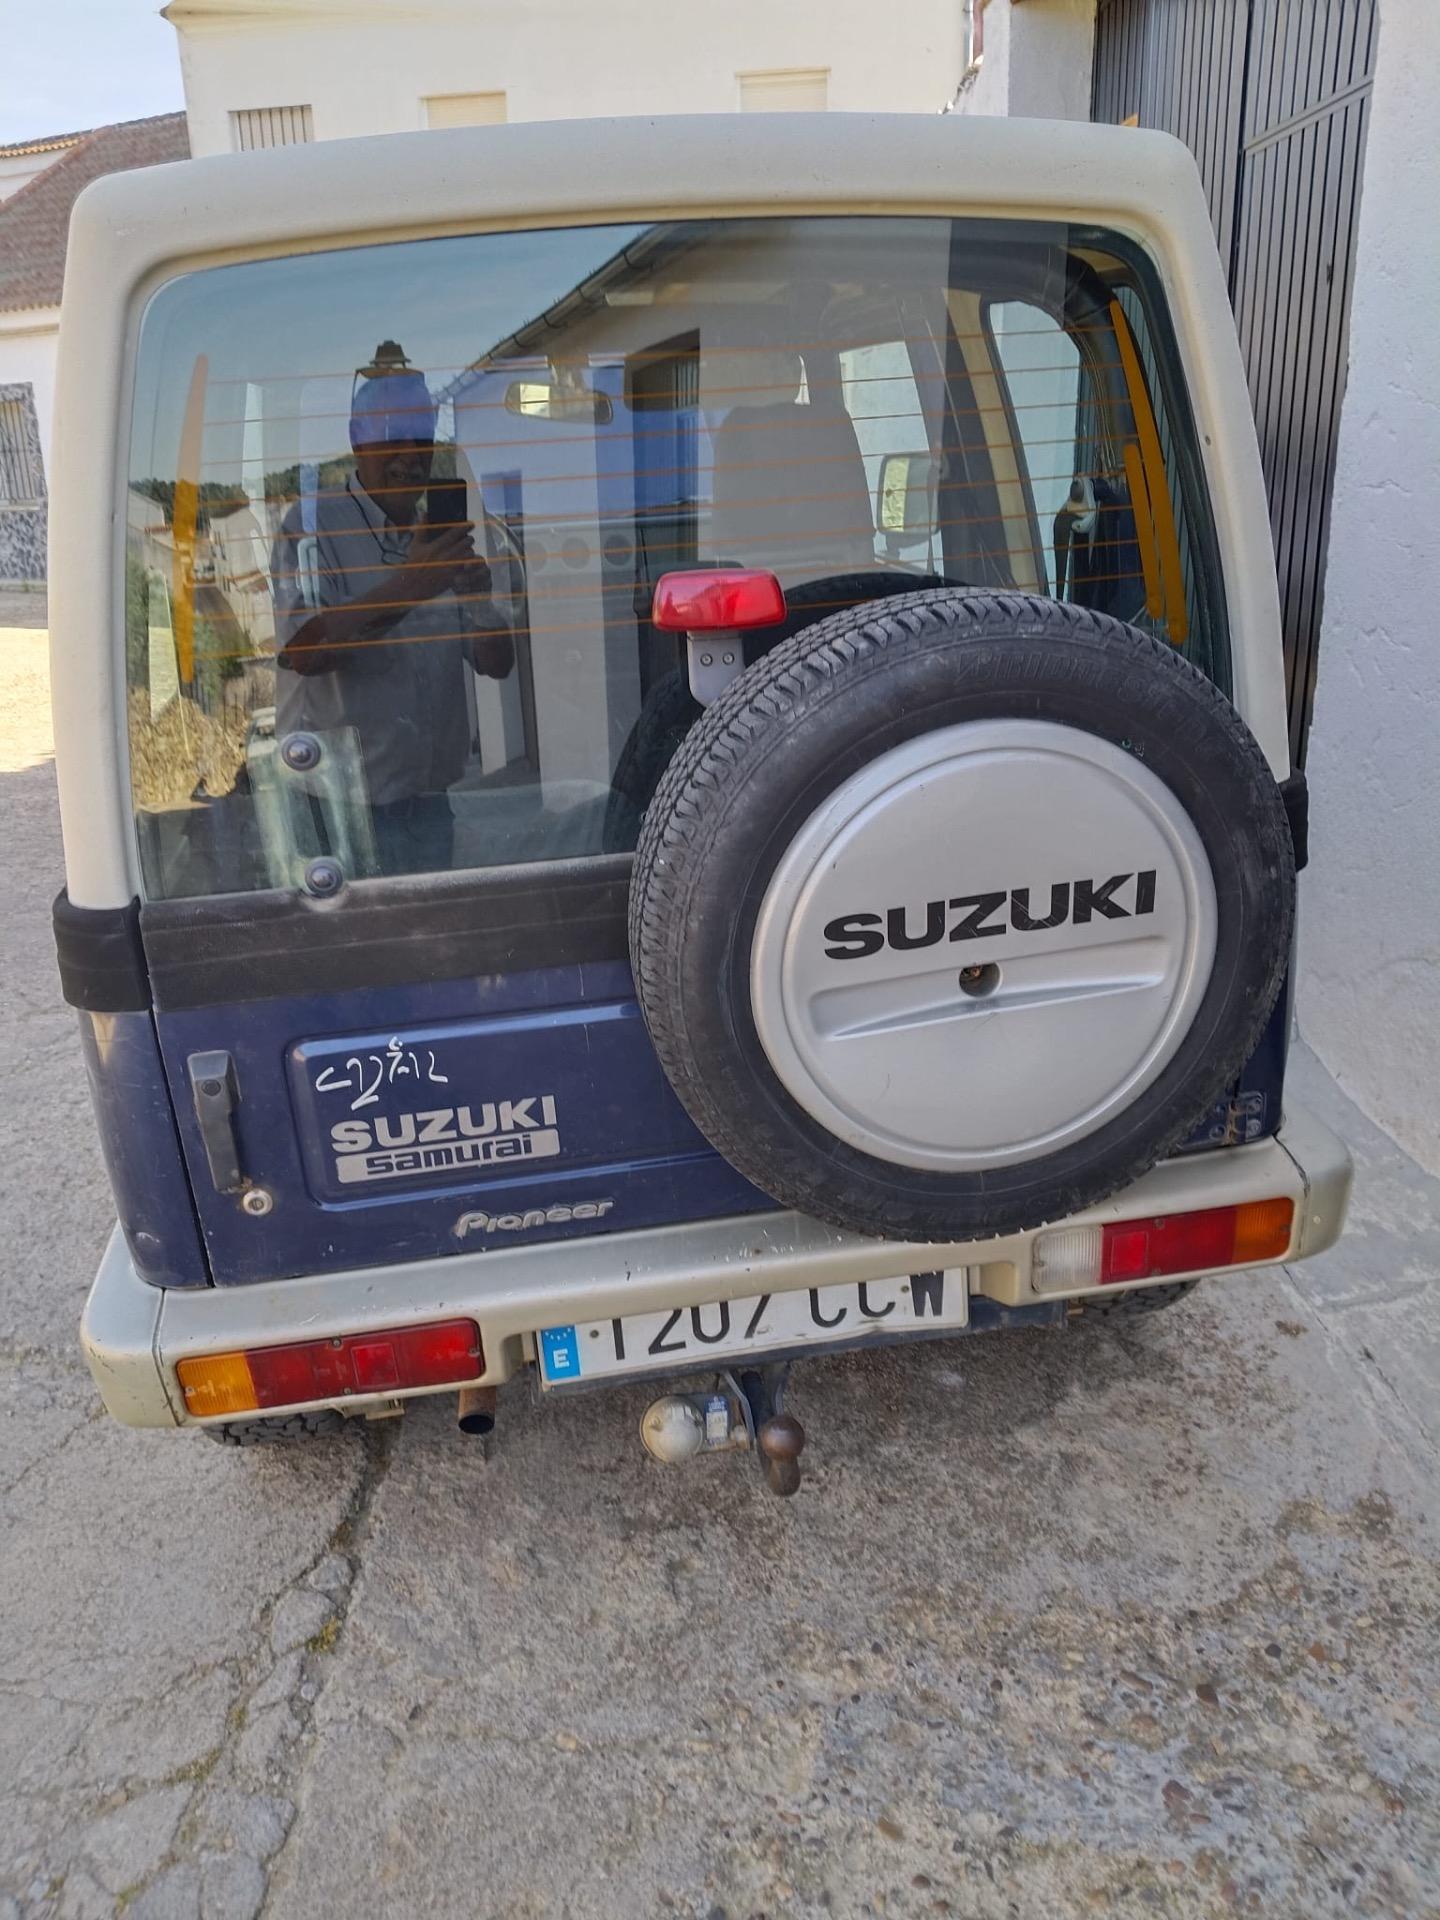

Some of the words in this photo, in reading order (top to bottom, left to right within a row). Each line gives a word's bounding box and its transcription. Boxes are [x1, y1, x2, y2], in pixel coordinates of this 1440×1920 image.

[823, 870, 1156, 960] SUZUKI
[330, 1095, 557, 1153] SUZUKI
[366, 1134, 532, 1176] samurai
[455, 1201, 614, 1239] Pioneer
[552, 1348, 571, 1369] E
